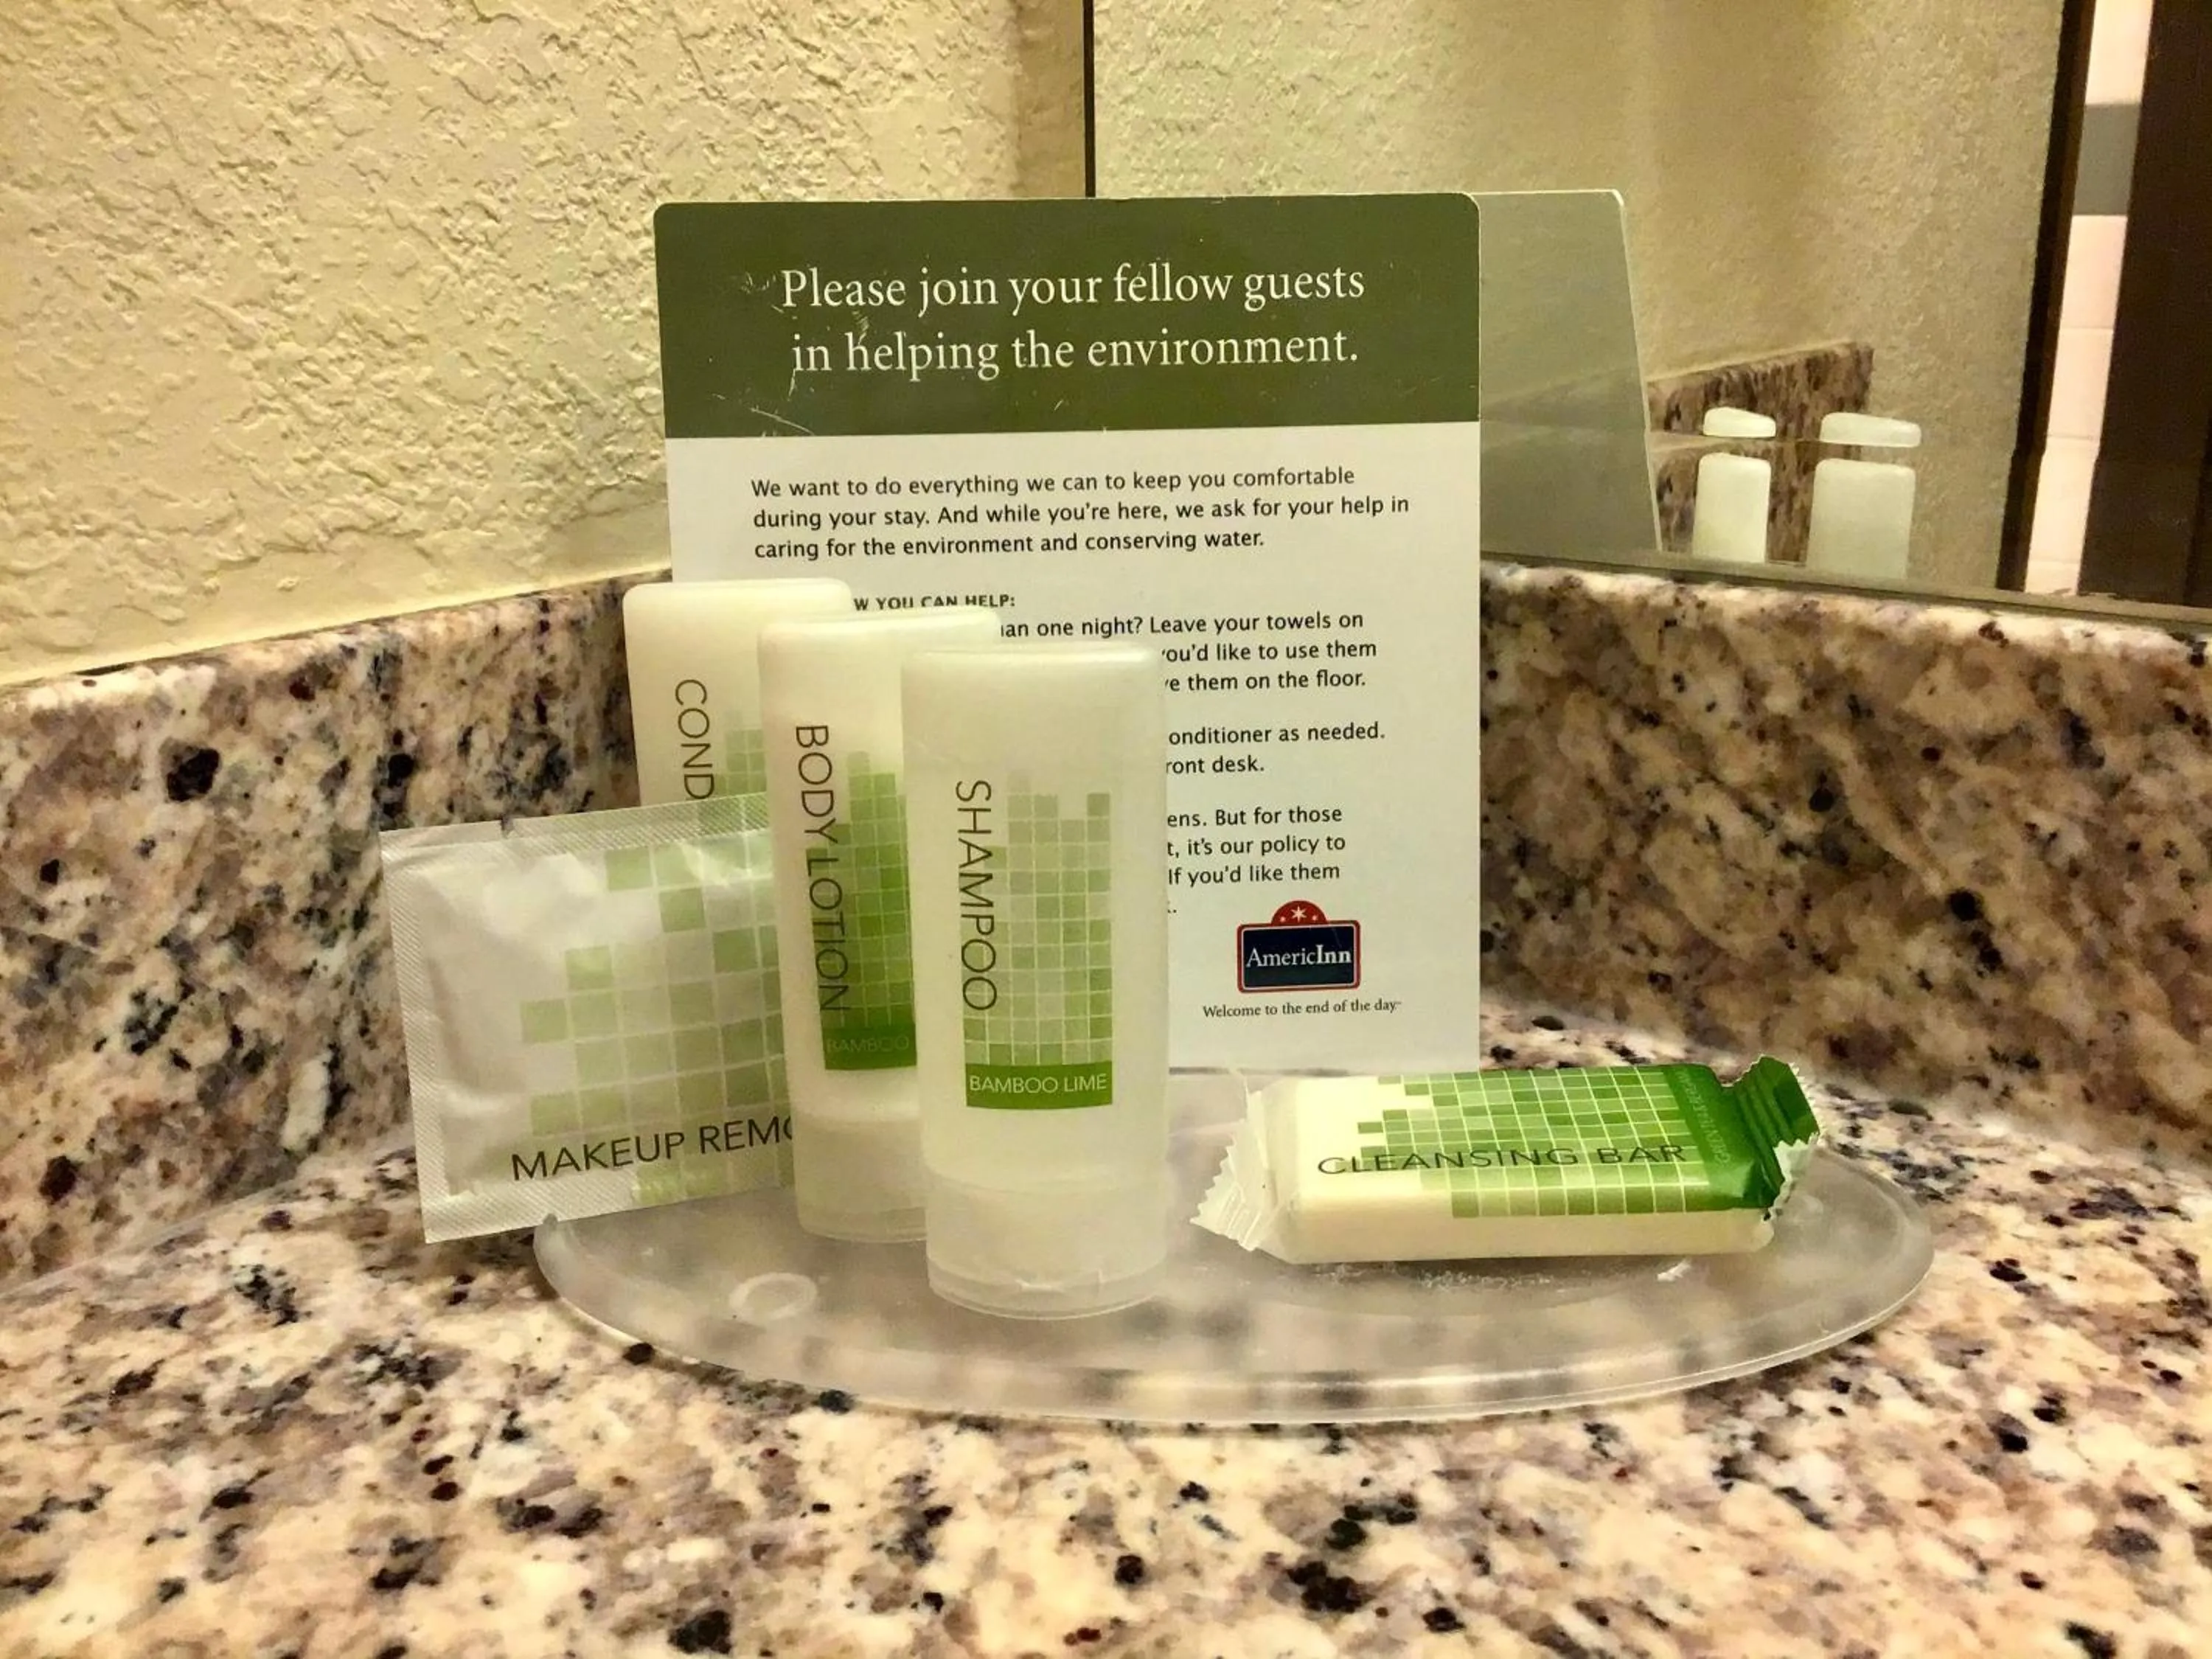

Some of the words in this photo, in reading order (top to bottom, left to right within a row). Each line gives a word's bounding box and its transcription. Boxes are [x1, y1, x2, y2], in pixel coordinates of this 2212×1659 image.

[782, 267, 905, 307] Please
[918, 266, 998, 318] join
[1008, 277, 1102, 316] your
[1113, 262, 1234, 302] fellow
[1244, 268, 1364, 312] guests
[793, 333, 832, 371] in
[844, 330, 1000, 382] helping
[1012, 329, 1074, 368] the
[1088, 327, 1357, 366] environment.
[751, 480, 781, 497] We
[789, 481, 840, 496] want
[847, 480, 868, 495] to
[875, 476, 902, 495] do
[909, 475, 1018, 498] everything
[1026, 478, 1055, 492] we
[1062, 477, 1097, 491] can
[1105, 475, 1126, 490] to
[1133, 471, 1181, 493] keep
[1188, 474, 1225, 492] you
[1233, 466, 1354, 487] comfortable
[754, 509, 821, 532] during
[829, 512, 877, 530] your
[884, 509, 930, 529] stay.
[937, 504, 978, 524] And
[986, 504, 1040, 523] while
[1048, 502, 1110, 526] you're
[1118, 501, 1167, 521] here,
[1175, 504, 1204, 518] we
[1211, 498, 1245, 518] ask
[1253, 498, 1281, 516] for
[1287, 501, 1334, 520] your
[1341, 495, 1384, 517] help
[1391, 495, 1409, 512] in
[754, 540, 818, 561] caring
[826, 538, 856, 557] for
[863, 538, 895, 556] the
[903, 536, 1033, 555] environment
[1040, 532, 1077, 552] and
[1085, 535, 1197, 552] conserving
[1204, 532, 1264, 547] water.
[876, 597, 914, 611] YOU
[920, 595, 958, 608] CAN
[965, 594, 1015, 608] HELP:
[1037, 622, 1074, 636] one
[1082, 616, 1143, 639] night?
[1150, 616, 1206, 633] Leave
[1214, 617, 1260, 635] your
[1266, 611, 1331, 630] towels
[1338, 614, 1363, 628] on
[1217, 643, 1251, 661] like
[1258, 645, 1279, 660] to
[1285, 645, 1319, 659] use
[1326, 639, 1377, 658] them
[1188, 673, 1238, 691] them
[1245, 675, 1270, 689] on
[1278, 670, 1309, 689] the
[1316, 669, 1366, 687] floor.
[675, 679, 715, 800] COND
[1279, 728, 1300, 742] as
[1307, 721, 1385, 741] needed.
[1211, 754, 1264, 773] desk.
[796, 725, 838, 844] BODY
[1215, 809, 1247, 826] But
[1253, 807, 1281, 824] for
[1288, 805, 1342, 824] those
[1188, 837, 1213, 856] it's
[1220, 841, 1253, 855] our
[1261, 835, 1320, 857] policy
[1326, 836, 1346, 850] to
[1169, 866, 1182, 885] If
[1187, 865, 1241, 888] you'd
[1250, 864, 1283, 882] like
[1290, 863, 1340, 880] them
[956, 779, 998, 1011] SHAMPOO
[807, 856, 851, 1012] LOTION
[1246, 944, 1352, 967] AmericInn
[1203, 1004, 1262, 1018] Welcome
[1265, 1005, 1278, 1015] to
[1282, 1002, 1302, 1015] the
[1305, 1001, 1329, 1014] end
[1332, 999, 1348, 1012] of
[1350, 998, 1371, 1012] the
[970, 1075, 1058, 1093] BAMBOO
[1064, 1074, 1107, 1093] LIME
[512, 1132, 685, 1180] MAKEUP
[1317, 1148, 1577, 1175] CLEANSING
[1599, 1144, 1686, 1164] BAR
